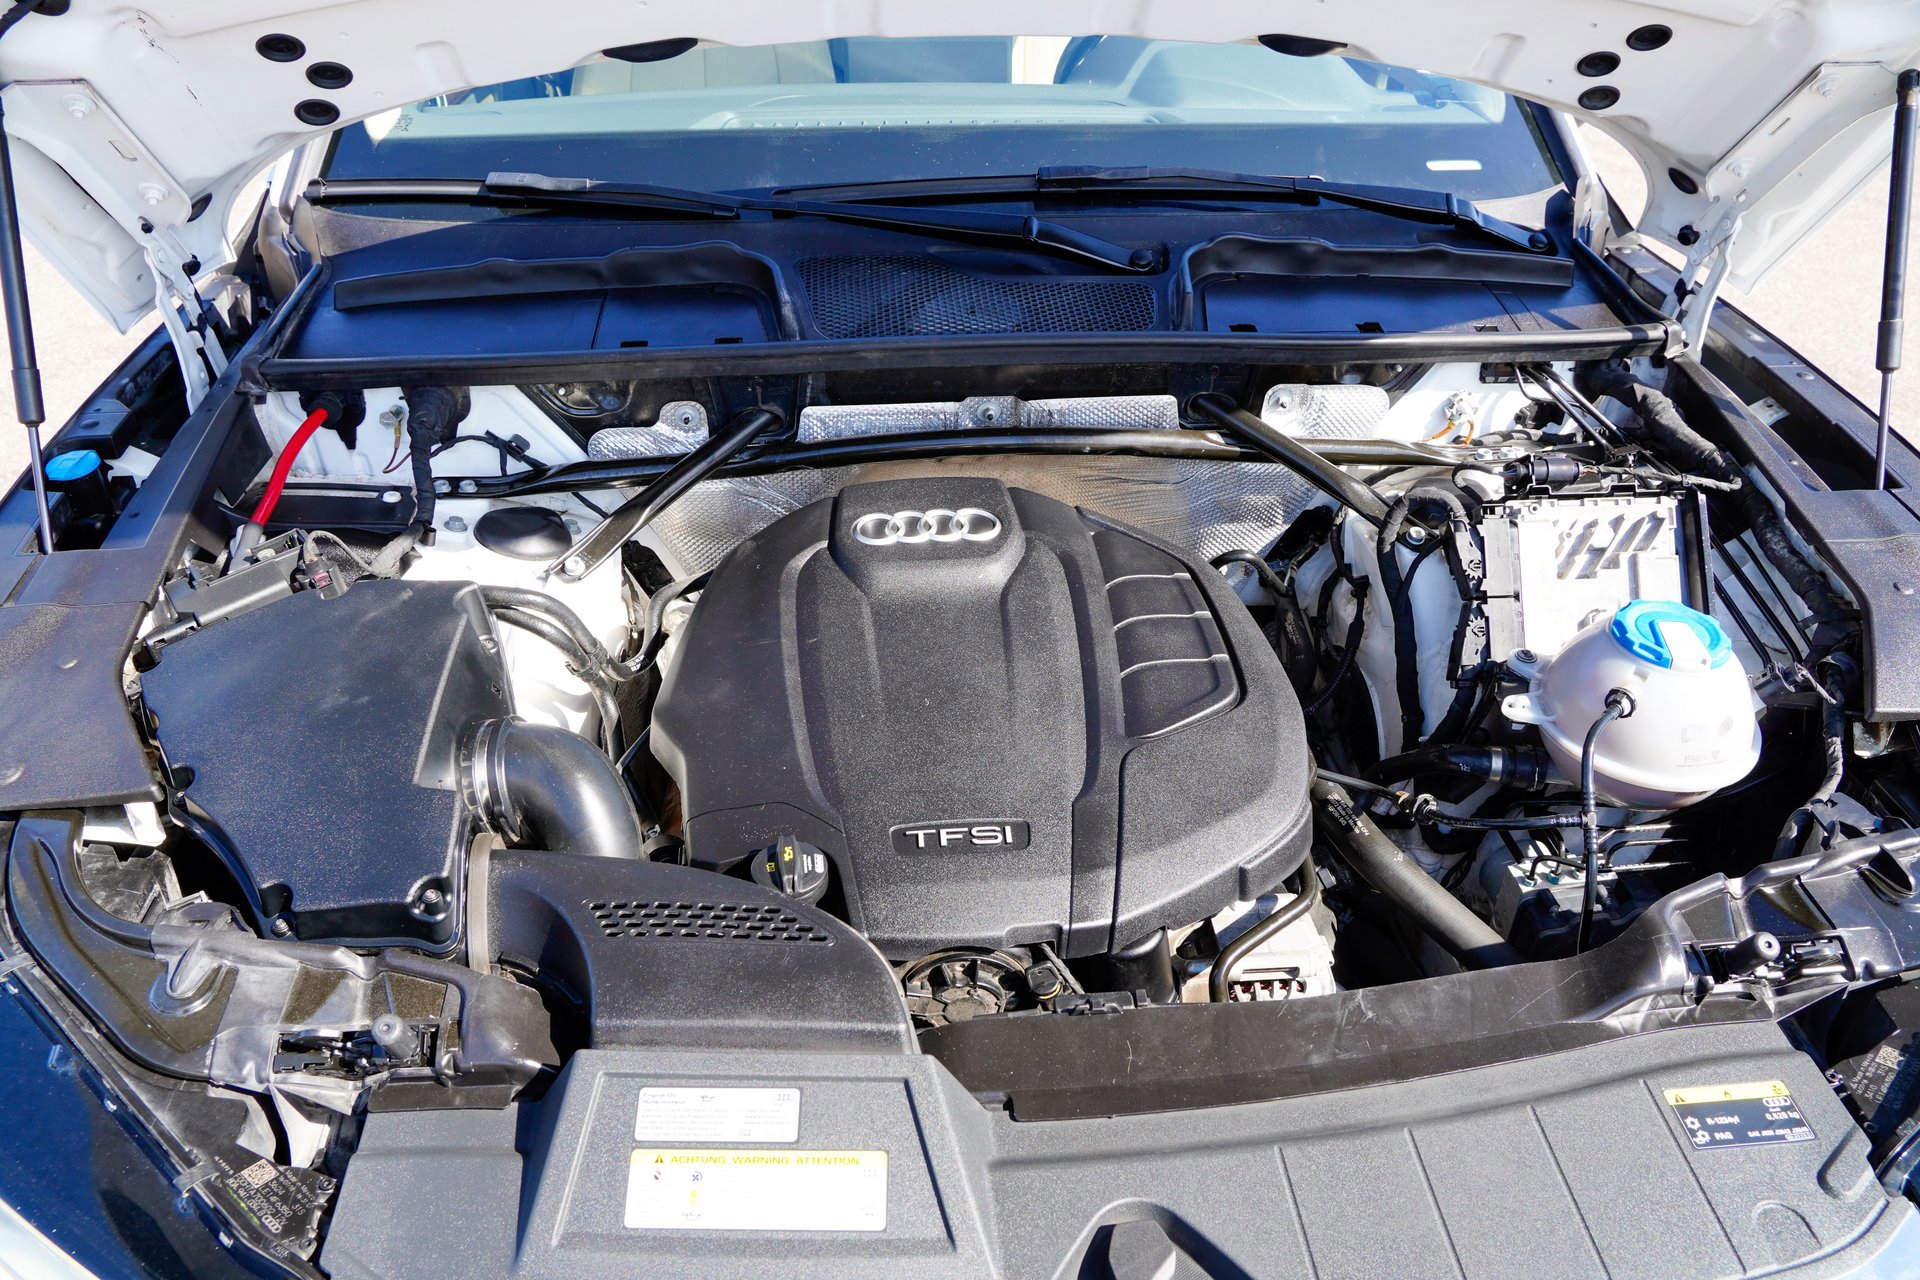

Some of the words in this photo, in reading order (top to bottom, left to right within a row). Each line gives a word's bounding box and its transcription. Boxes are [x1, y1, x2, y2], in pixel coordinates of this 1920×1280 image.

[904, 825, 1013, 848] TFSI
[1714, 1132, 1734, 1140] PAG
[670, 1155, 726, 1165] ACHTUNG
[732, 1155, 789, 1165] WARNING
[796, 1156, 860, 1165] ATTENTION
